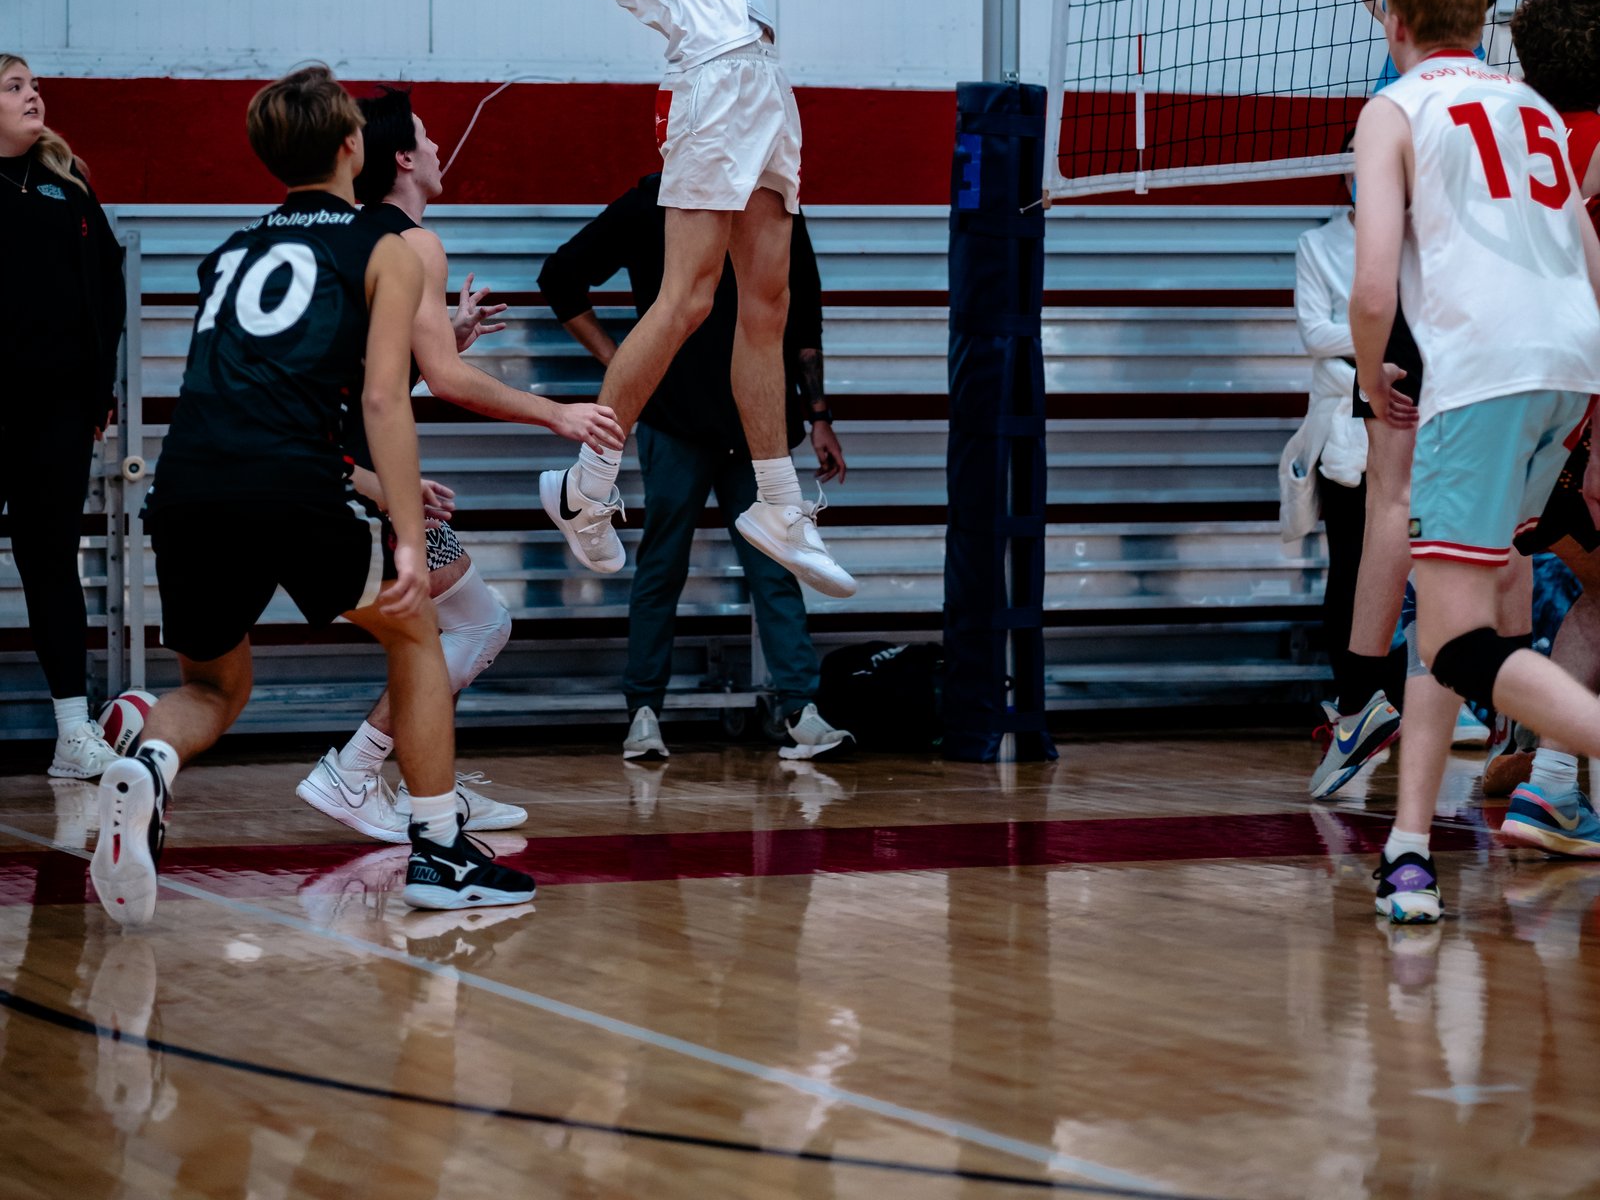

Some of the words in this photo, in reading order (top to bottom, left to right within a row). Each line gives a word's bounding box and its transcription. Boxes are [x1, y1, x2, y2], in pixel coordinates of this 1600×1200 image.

[1420, 67, 1456, 81] 630
[1447, 102, 1571, 210] 15
[266, 209, 356, 227] Volleyball
[197, 242, 317, 337] 10
